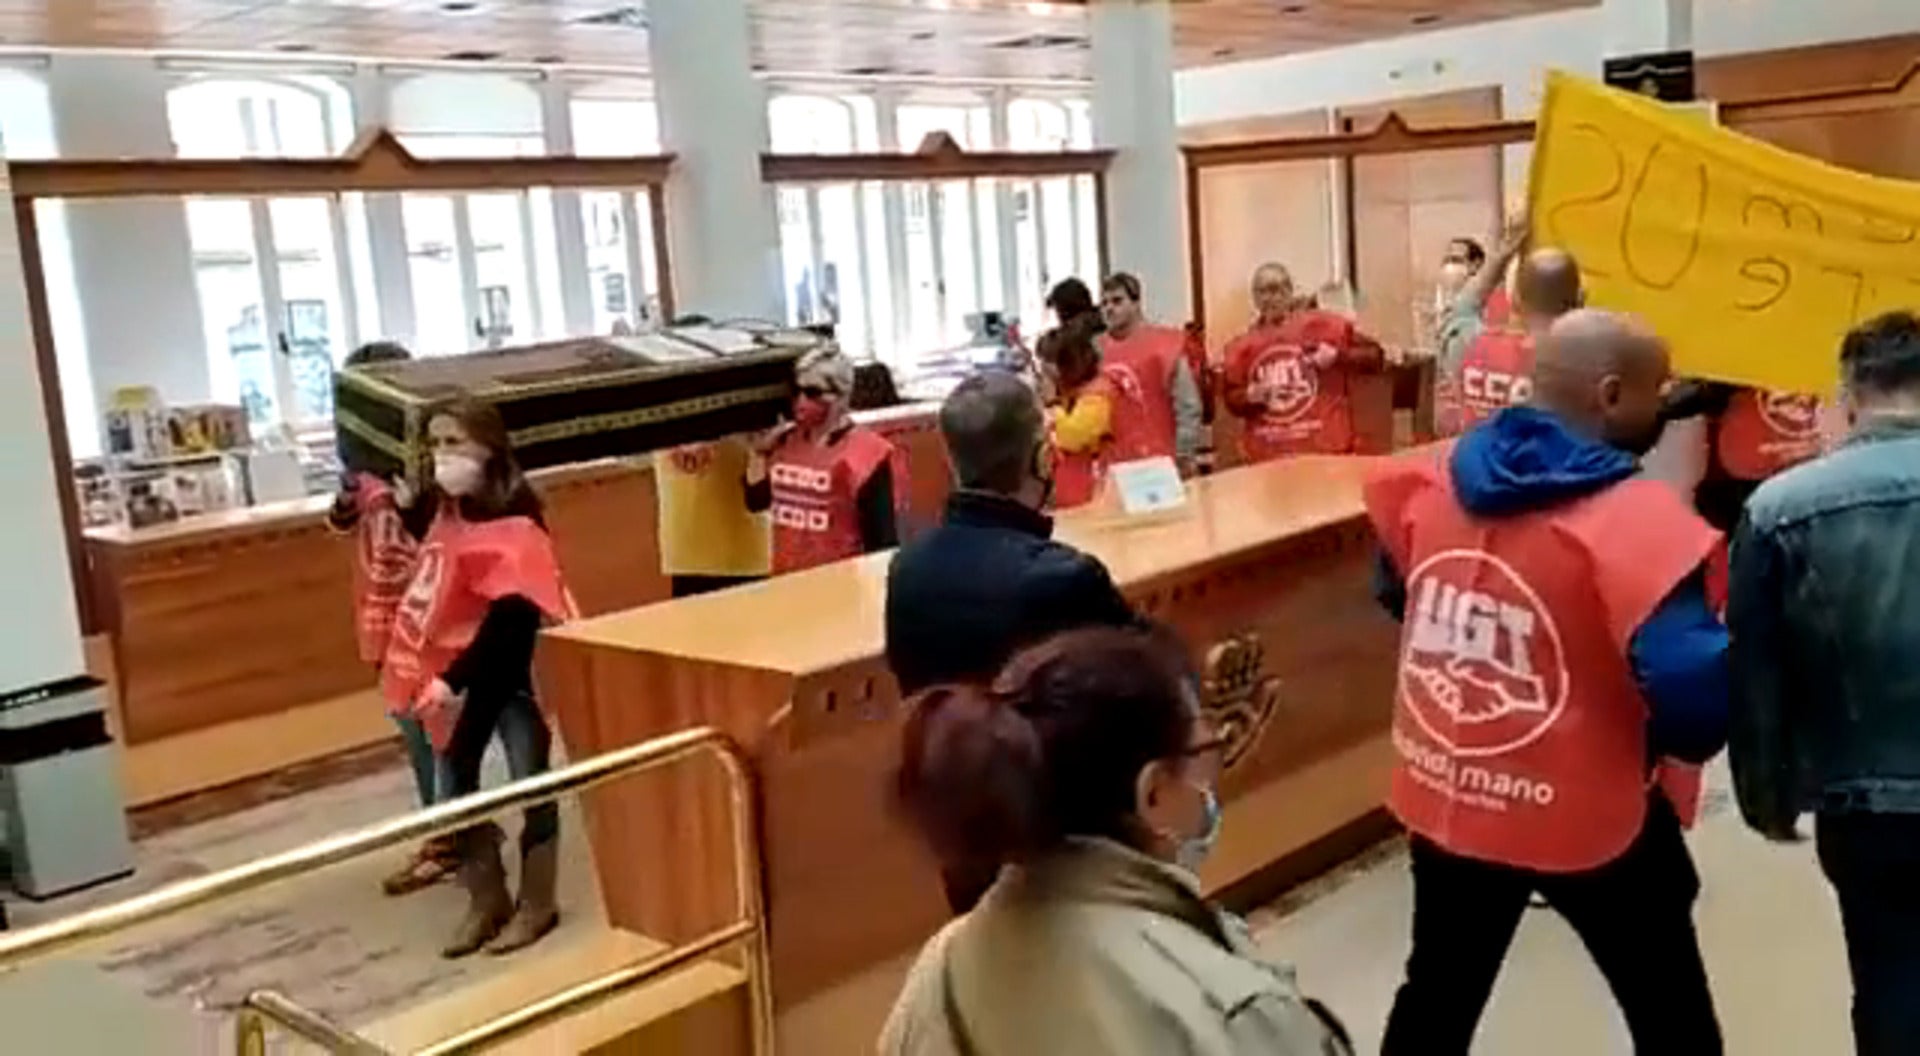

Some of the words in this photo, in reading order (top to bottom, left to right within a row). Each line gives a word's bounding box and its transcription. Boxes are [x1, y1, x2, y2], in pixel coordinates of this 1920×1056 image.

[1463, 366, 1533, 404] CCO
[1410, 576, 1534, 675] UGT
[1460, 765, 1554, 805] mano
